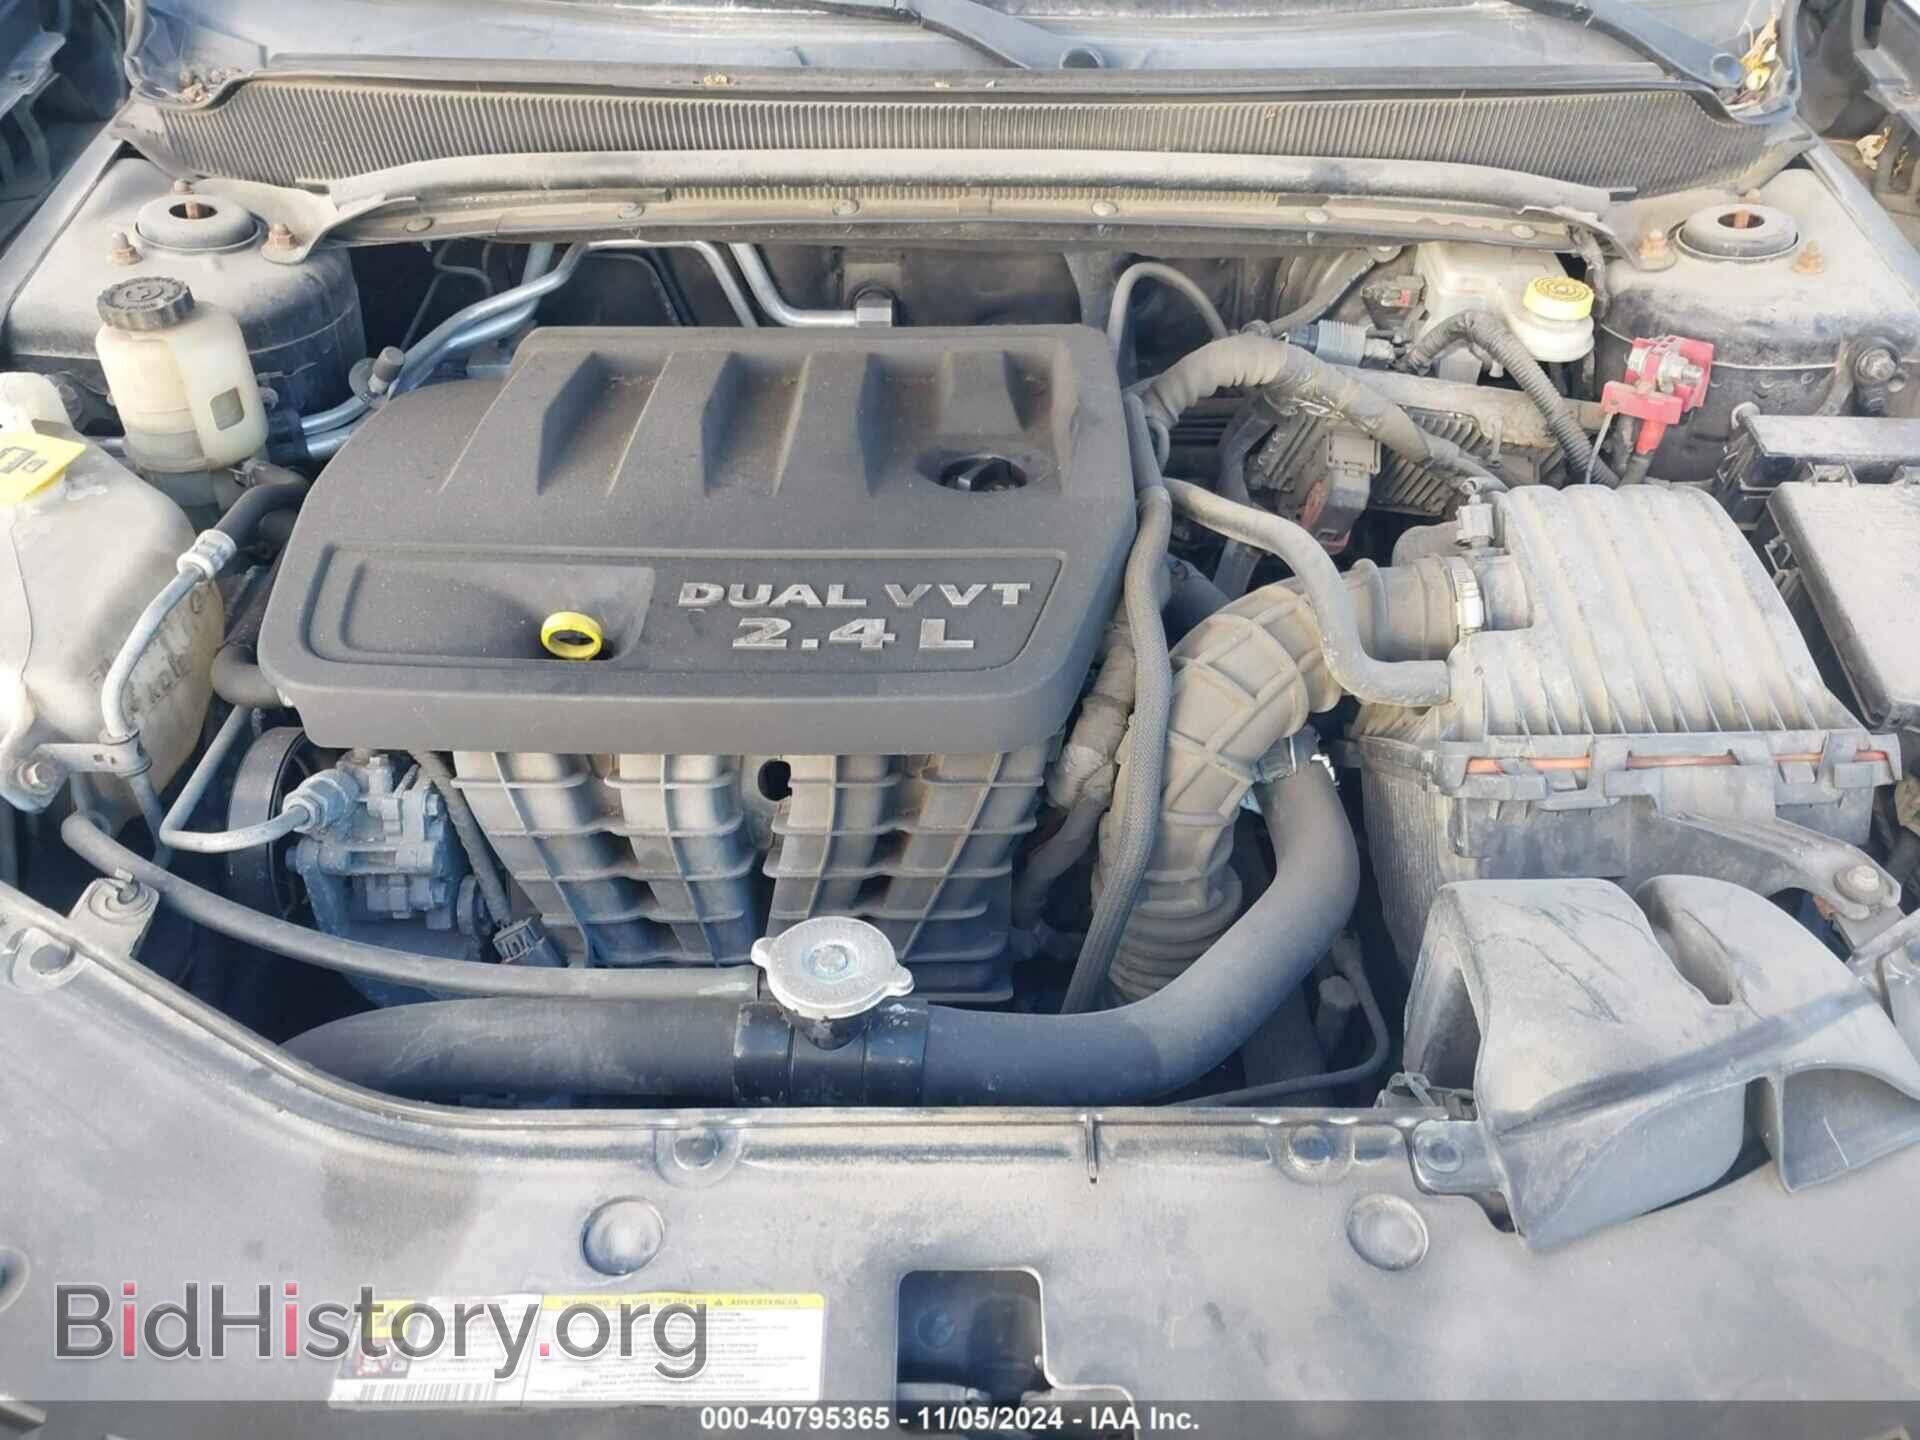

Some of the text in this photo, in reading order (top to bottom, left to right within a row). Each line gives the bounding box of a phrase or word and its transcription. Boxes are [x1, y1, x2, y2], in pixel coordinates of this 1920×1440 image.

[677, 582, 1031, 607] DUAL VVT
[732, 616, 974, 649] 2.4 L
